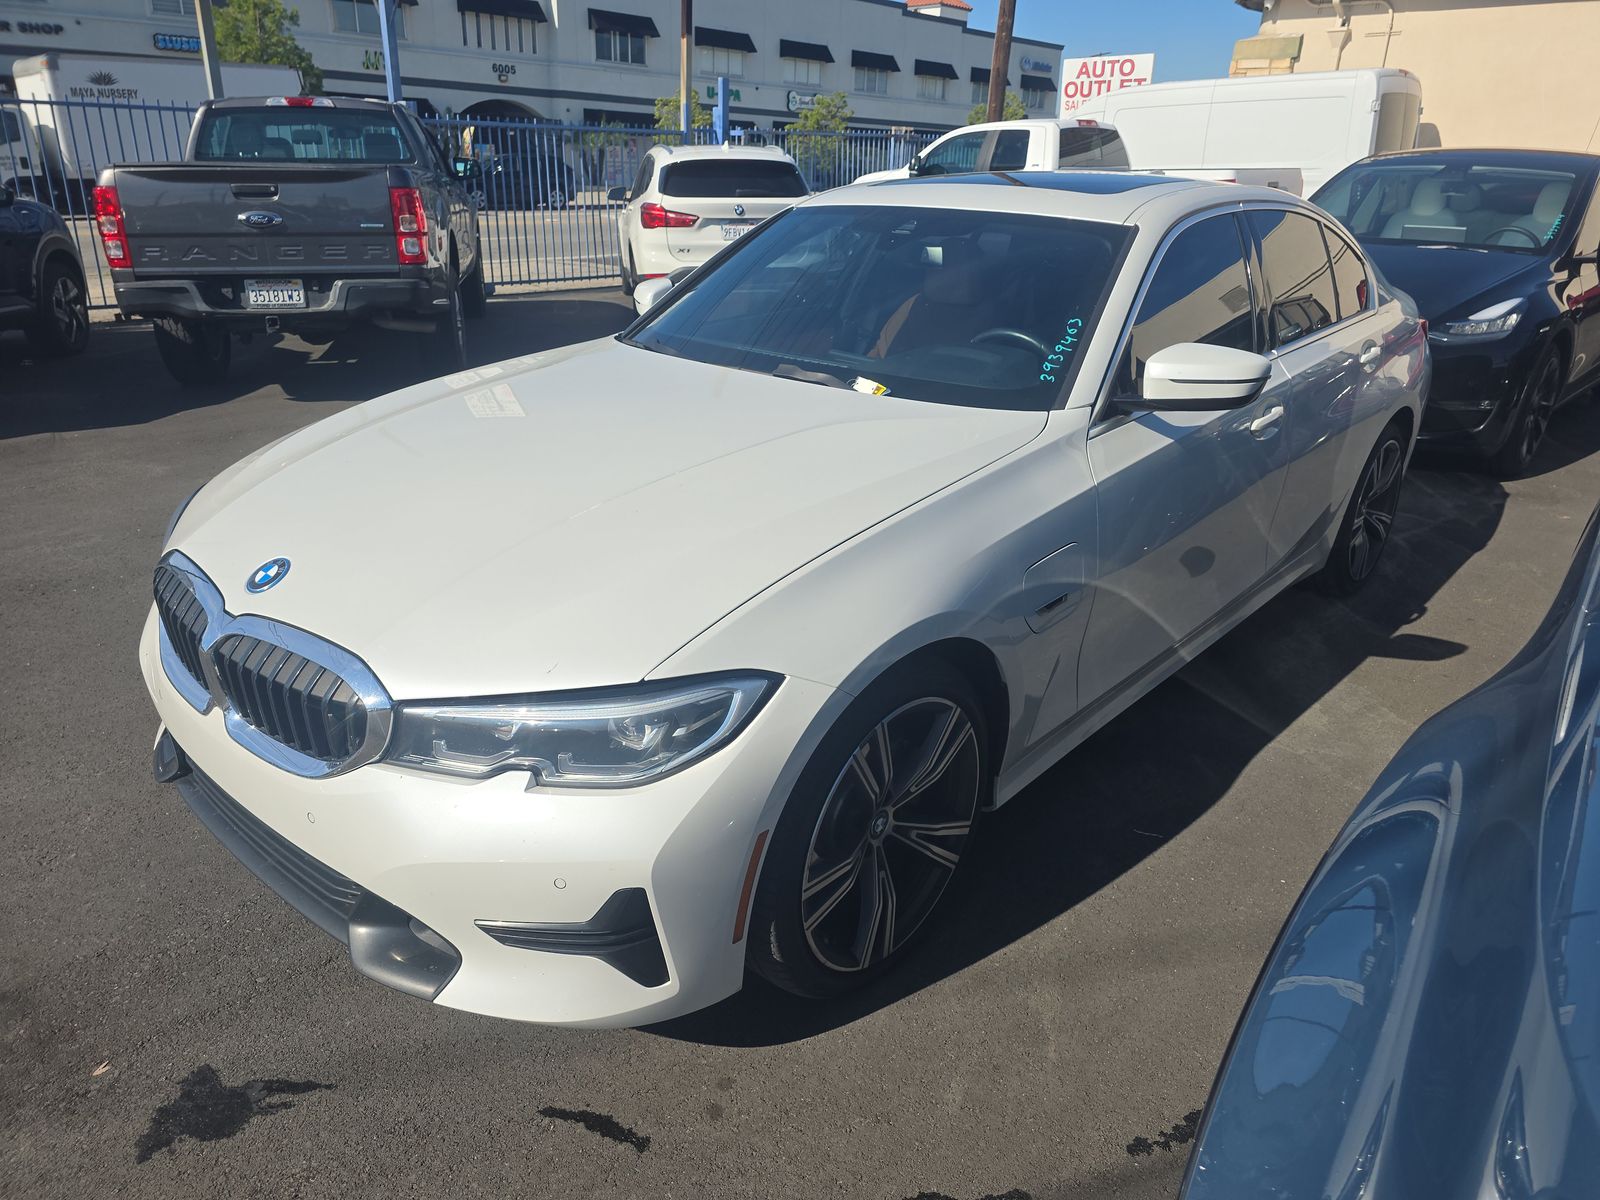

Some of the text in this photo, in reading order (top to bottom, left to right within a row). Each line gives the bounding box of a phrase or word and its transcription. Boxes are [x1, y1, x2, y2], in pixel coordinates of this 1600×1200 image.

[17, 21, 64, 35] SHOP
[492, 63, 517, 75] 6005
[1076, 59, 1136, 79] AUTO
[70, 87, 138, 99] MAYA NURSERY
[140, 246, 391, 261] RANGER
[251, 289, 302, 302] 35181W3
